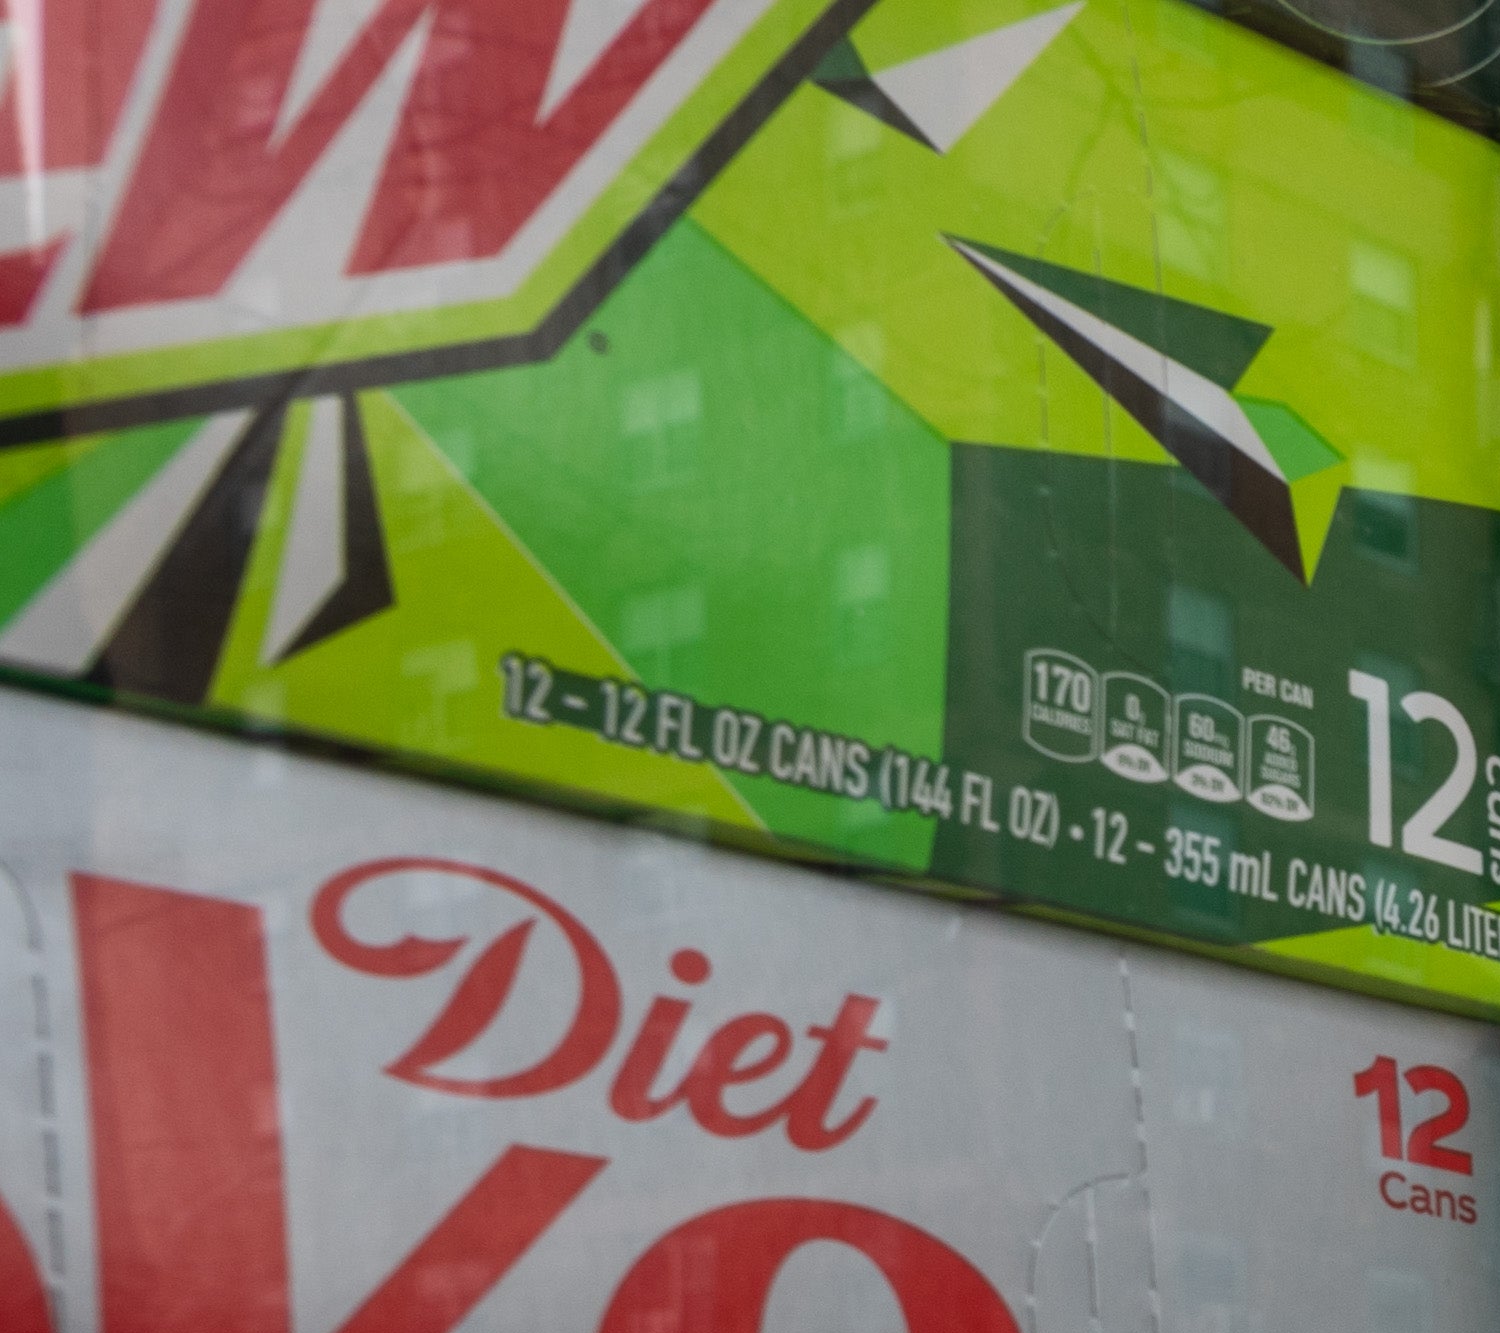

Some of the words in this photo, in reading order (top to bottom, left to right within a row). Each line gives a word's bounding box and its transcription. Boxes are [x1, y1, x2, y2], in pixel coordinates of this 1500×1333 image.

[1033, 661, 1091, 713] 170
[503, 653, 552, 722] 12
[602, 680, 647, 745] 12
[655, 694, 701, 760] FL
[713, 713, 761, 773] OZ
[770, 726, 870, 797] CANS
[880, 749, 952, 816] (144
[961, 772, 999, 832] FL
[1009, 786, 1059, 848] OZ)
[1093, 808, 1127, 864] 12
[1164, 828, 1220, 886] 355
[1230, 852, 1278, 901] mL
[1287, 860, 1366, 922] CANS
[1374, 879, 1439, 942] (4.26
[1348, 669, 1484, 875] 12
[309, 856, 890, 1152] Diet
[1354, 1054, 1475, 1175] 12
[1379, 1172, 1478, 1225] Cans
